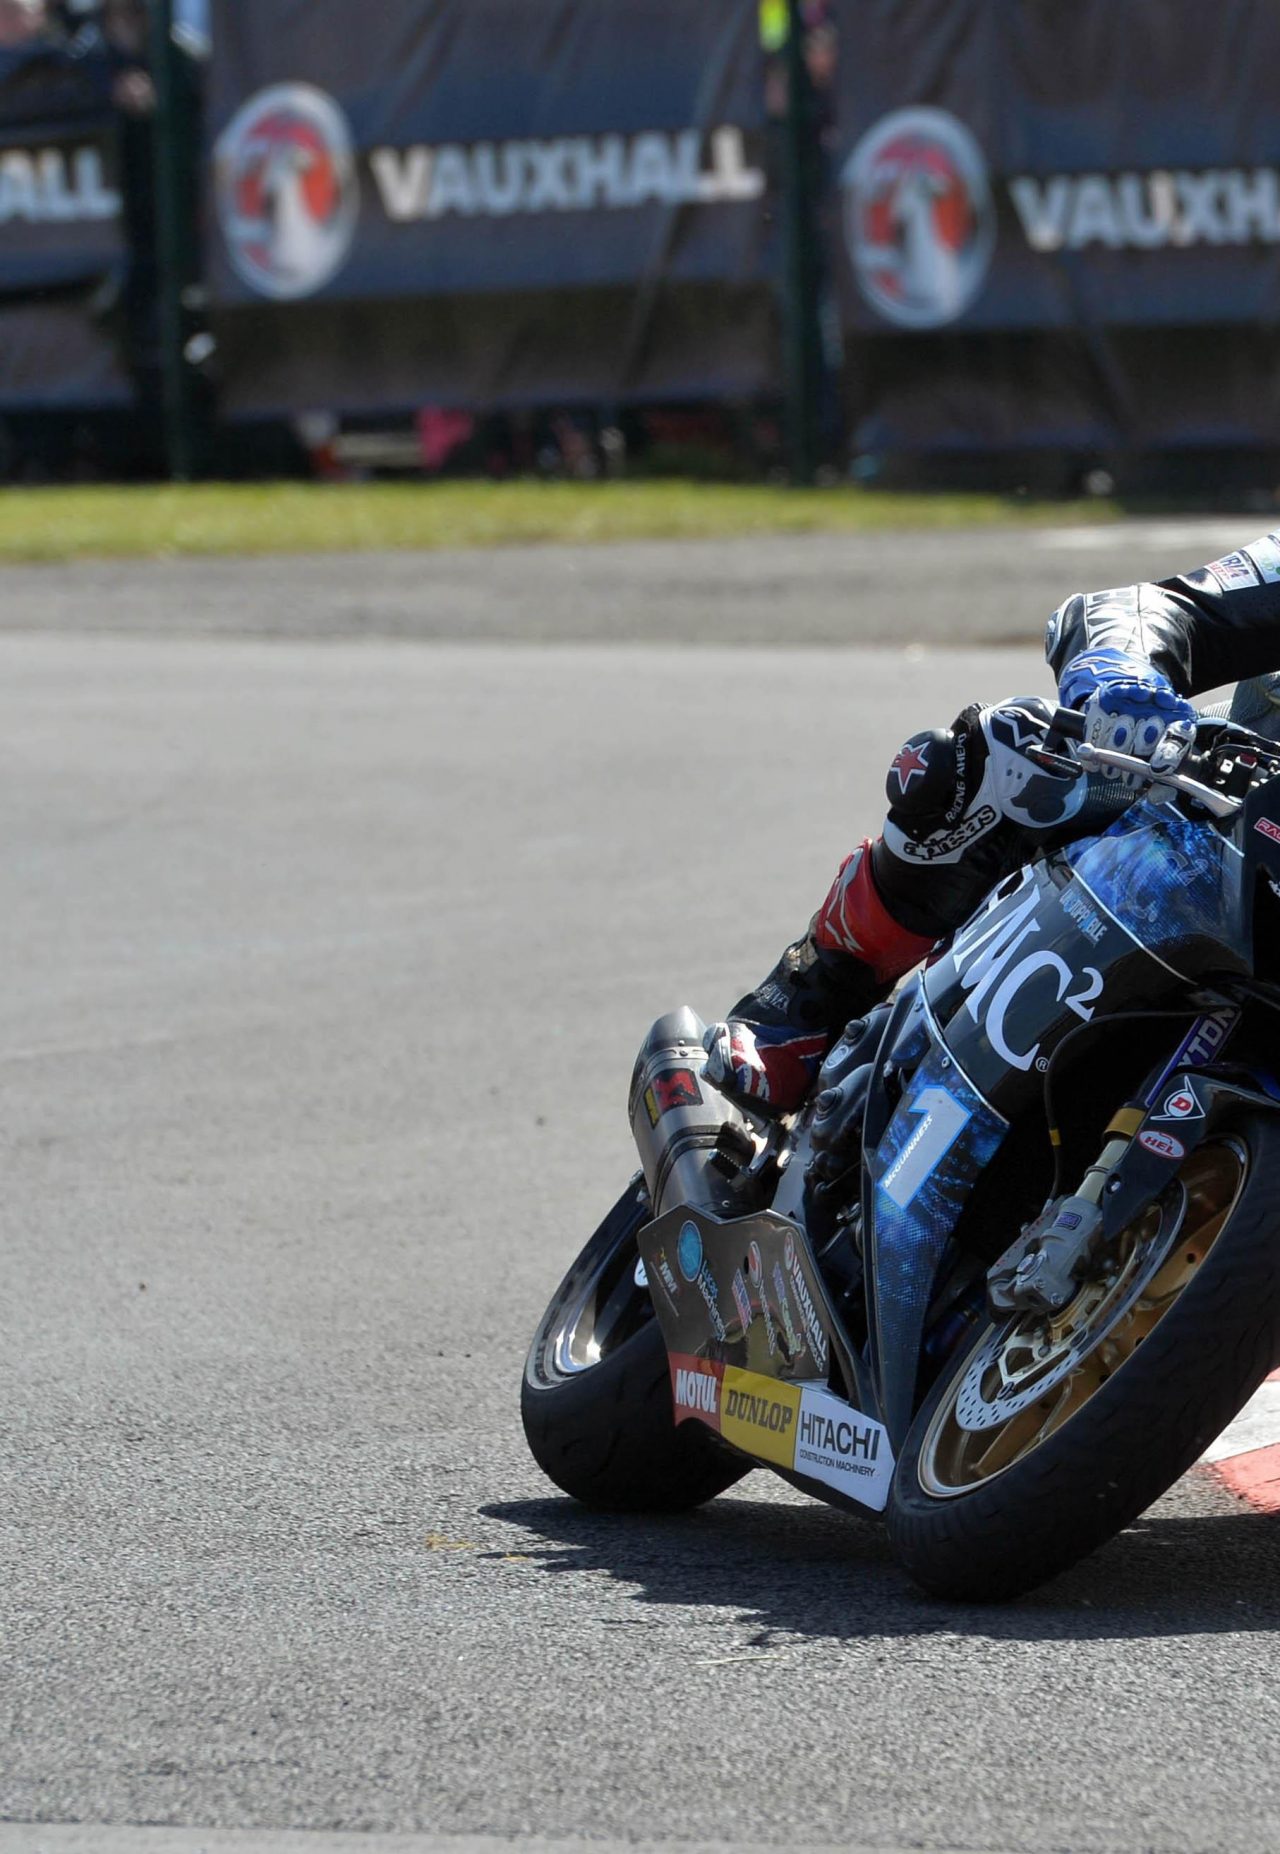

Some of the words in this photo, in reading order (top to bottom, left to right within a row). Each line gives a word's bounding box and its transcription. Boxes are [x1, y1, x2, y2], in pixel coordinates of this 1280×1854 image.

[370, 124, 764, 222] VAUXHALL
[908, 1084, 973, 1210] 1
[1145, 1137, 1174, 1156] HEL
[793, 1255, 826, 1361] VAUXHALL
[676, 1369, 717, 1413] MOTUL
[725, 1389, 793, 1433] DUNLOP
[800, 1410, 881, 1461] HITACHI
[836, 1460, 875, 1478] MACHINERY
